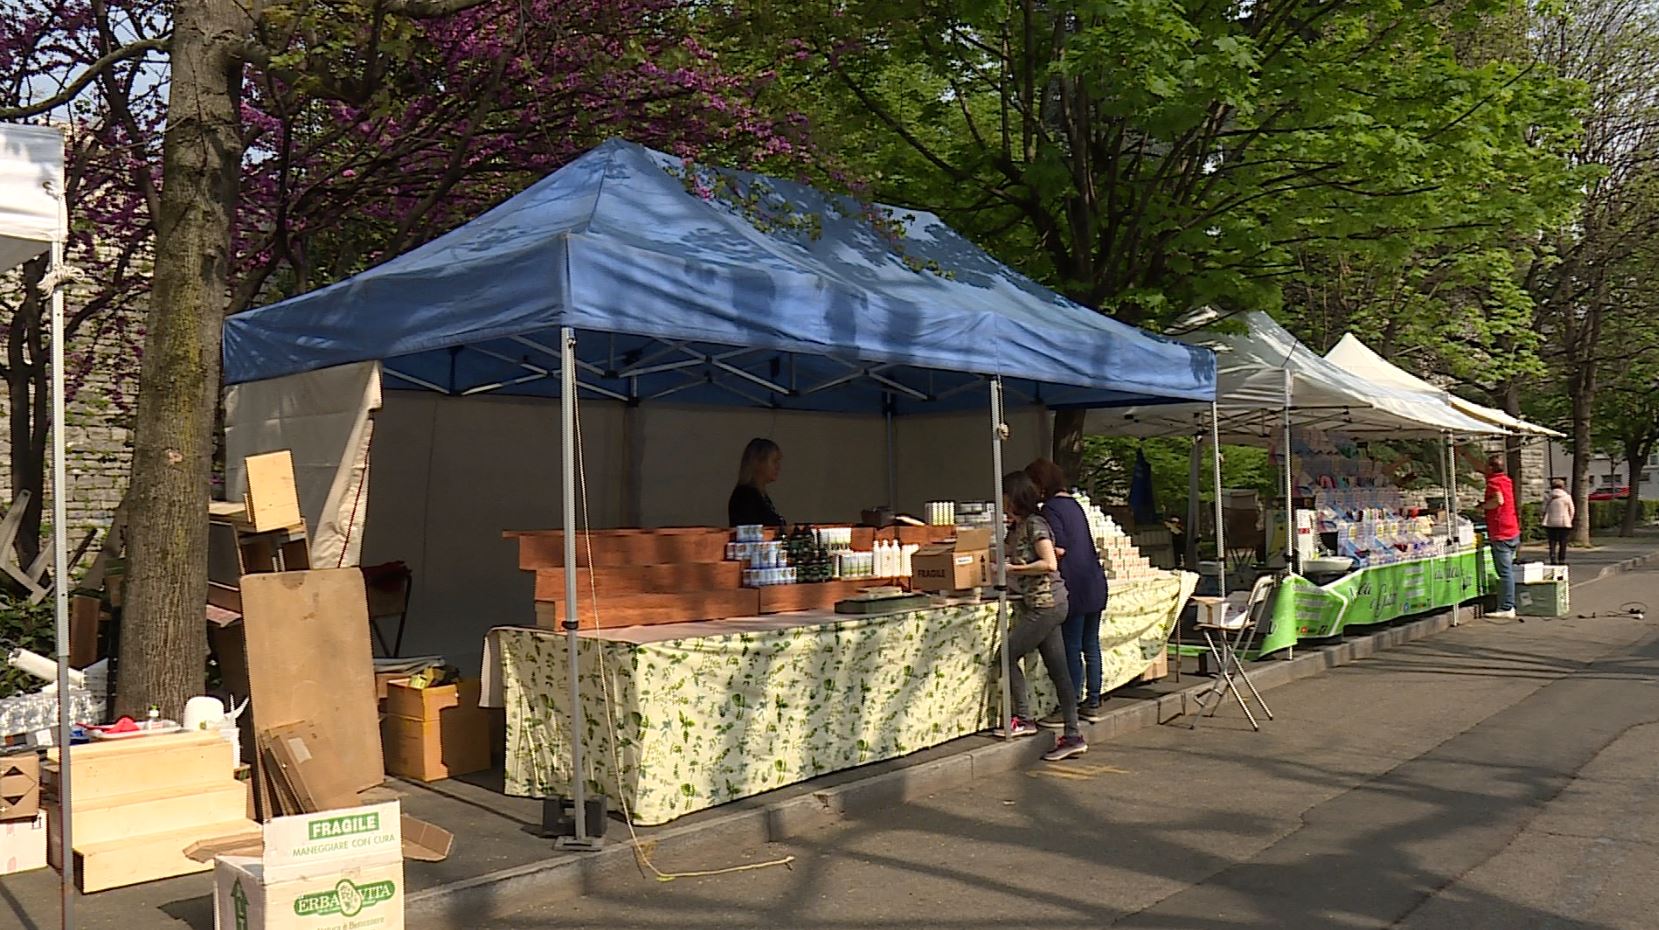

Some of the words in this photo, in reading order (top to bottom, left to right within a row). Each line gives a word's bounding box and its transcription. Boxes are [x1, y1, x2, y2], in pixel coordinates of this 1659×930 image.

[312, 815, 376, 838] FRAGILE
[293, 841, 349, 857] MANEGGIARE
[352, 837, 371, 848] CON
[374, 834, 395, 845] CURA
[298, 893, 340, 913] ERBA
[357, 884, 392, 900] VITA
